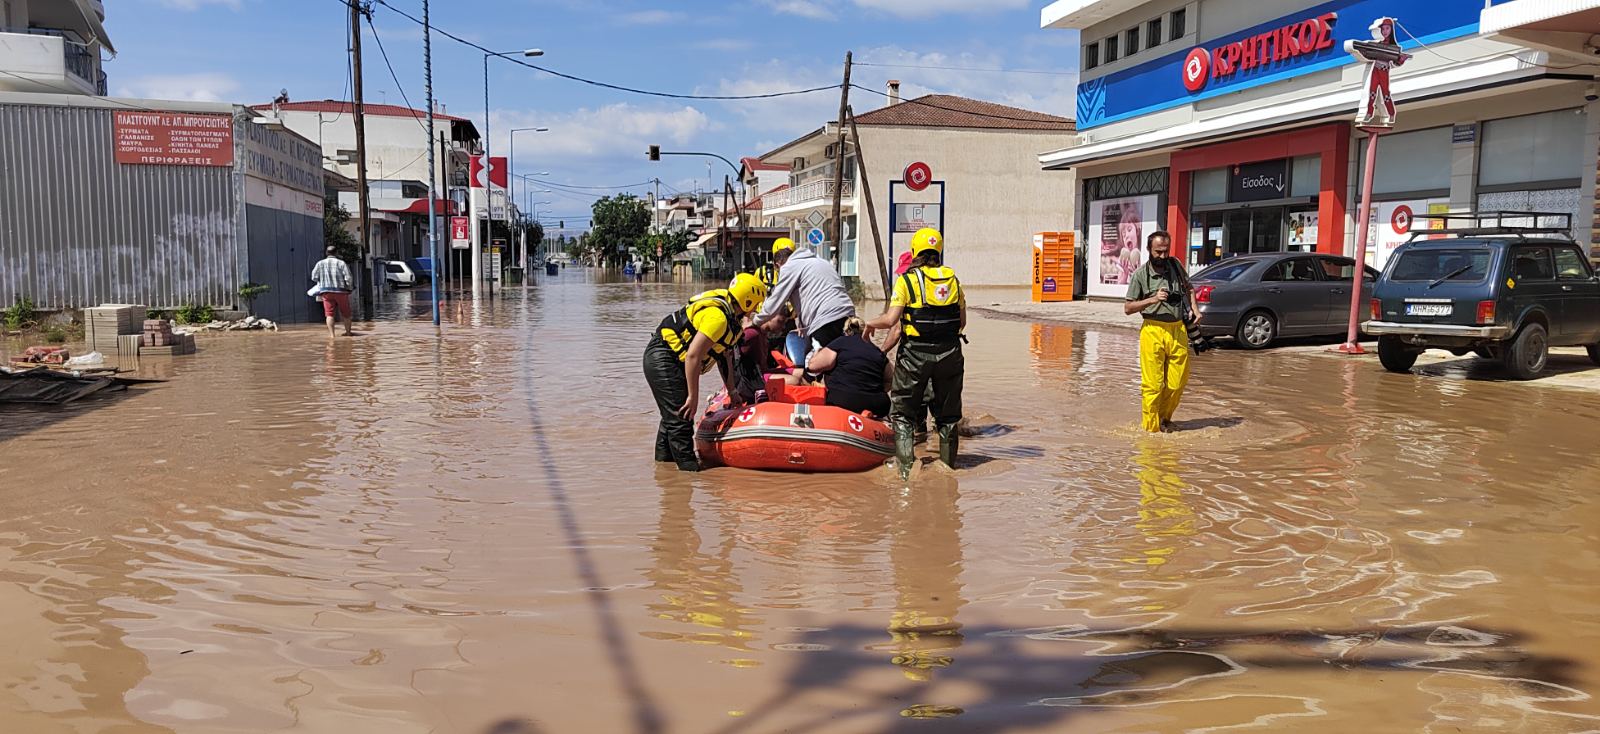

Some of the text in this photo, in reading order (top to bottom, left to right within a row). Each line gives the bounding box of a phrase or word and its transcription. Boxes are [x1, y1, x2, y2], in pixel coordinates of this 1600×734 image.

[1212, 12, 1337, 78] ΚΡΗΤΙΚΟΣ
[141, 156, 212, 165] ΠΕΡΙΦΡΑΞΕΙΣ
[1242, 175, 1274, 188] Είσοδος
